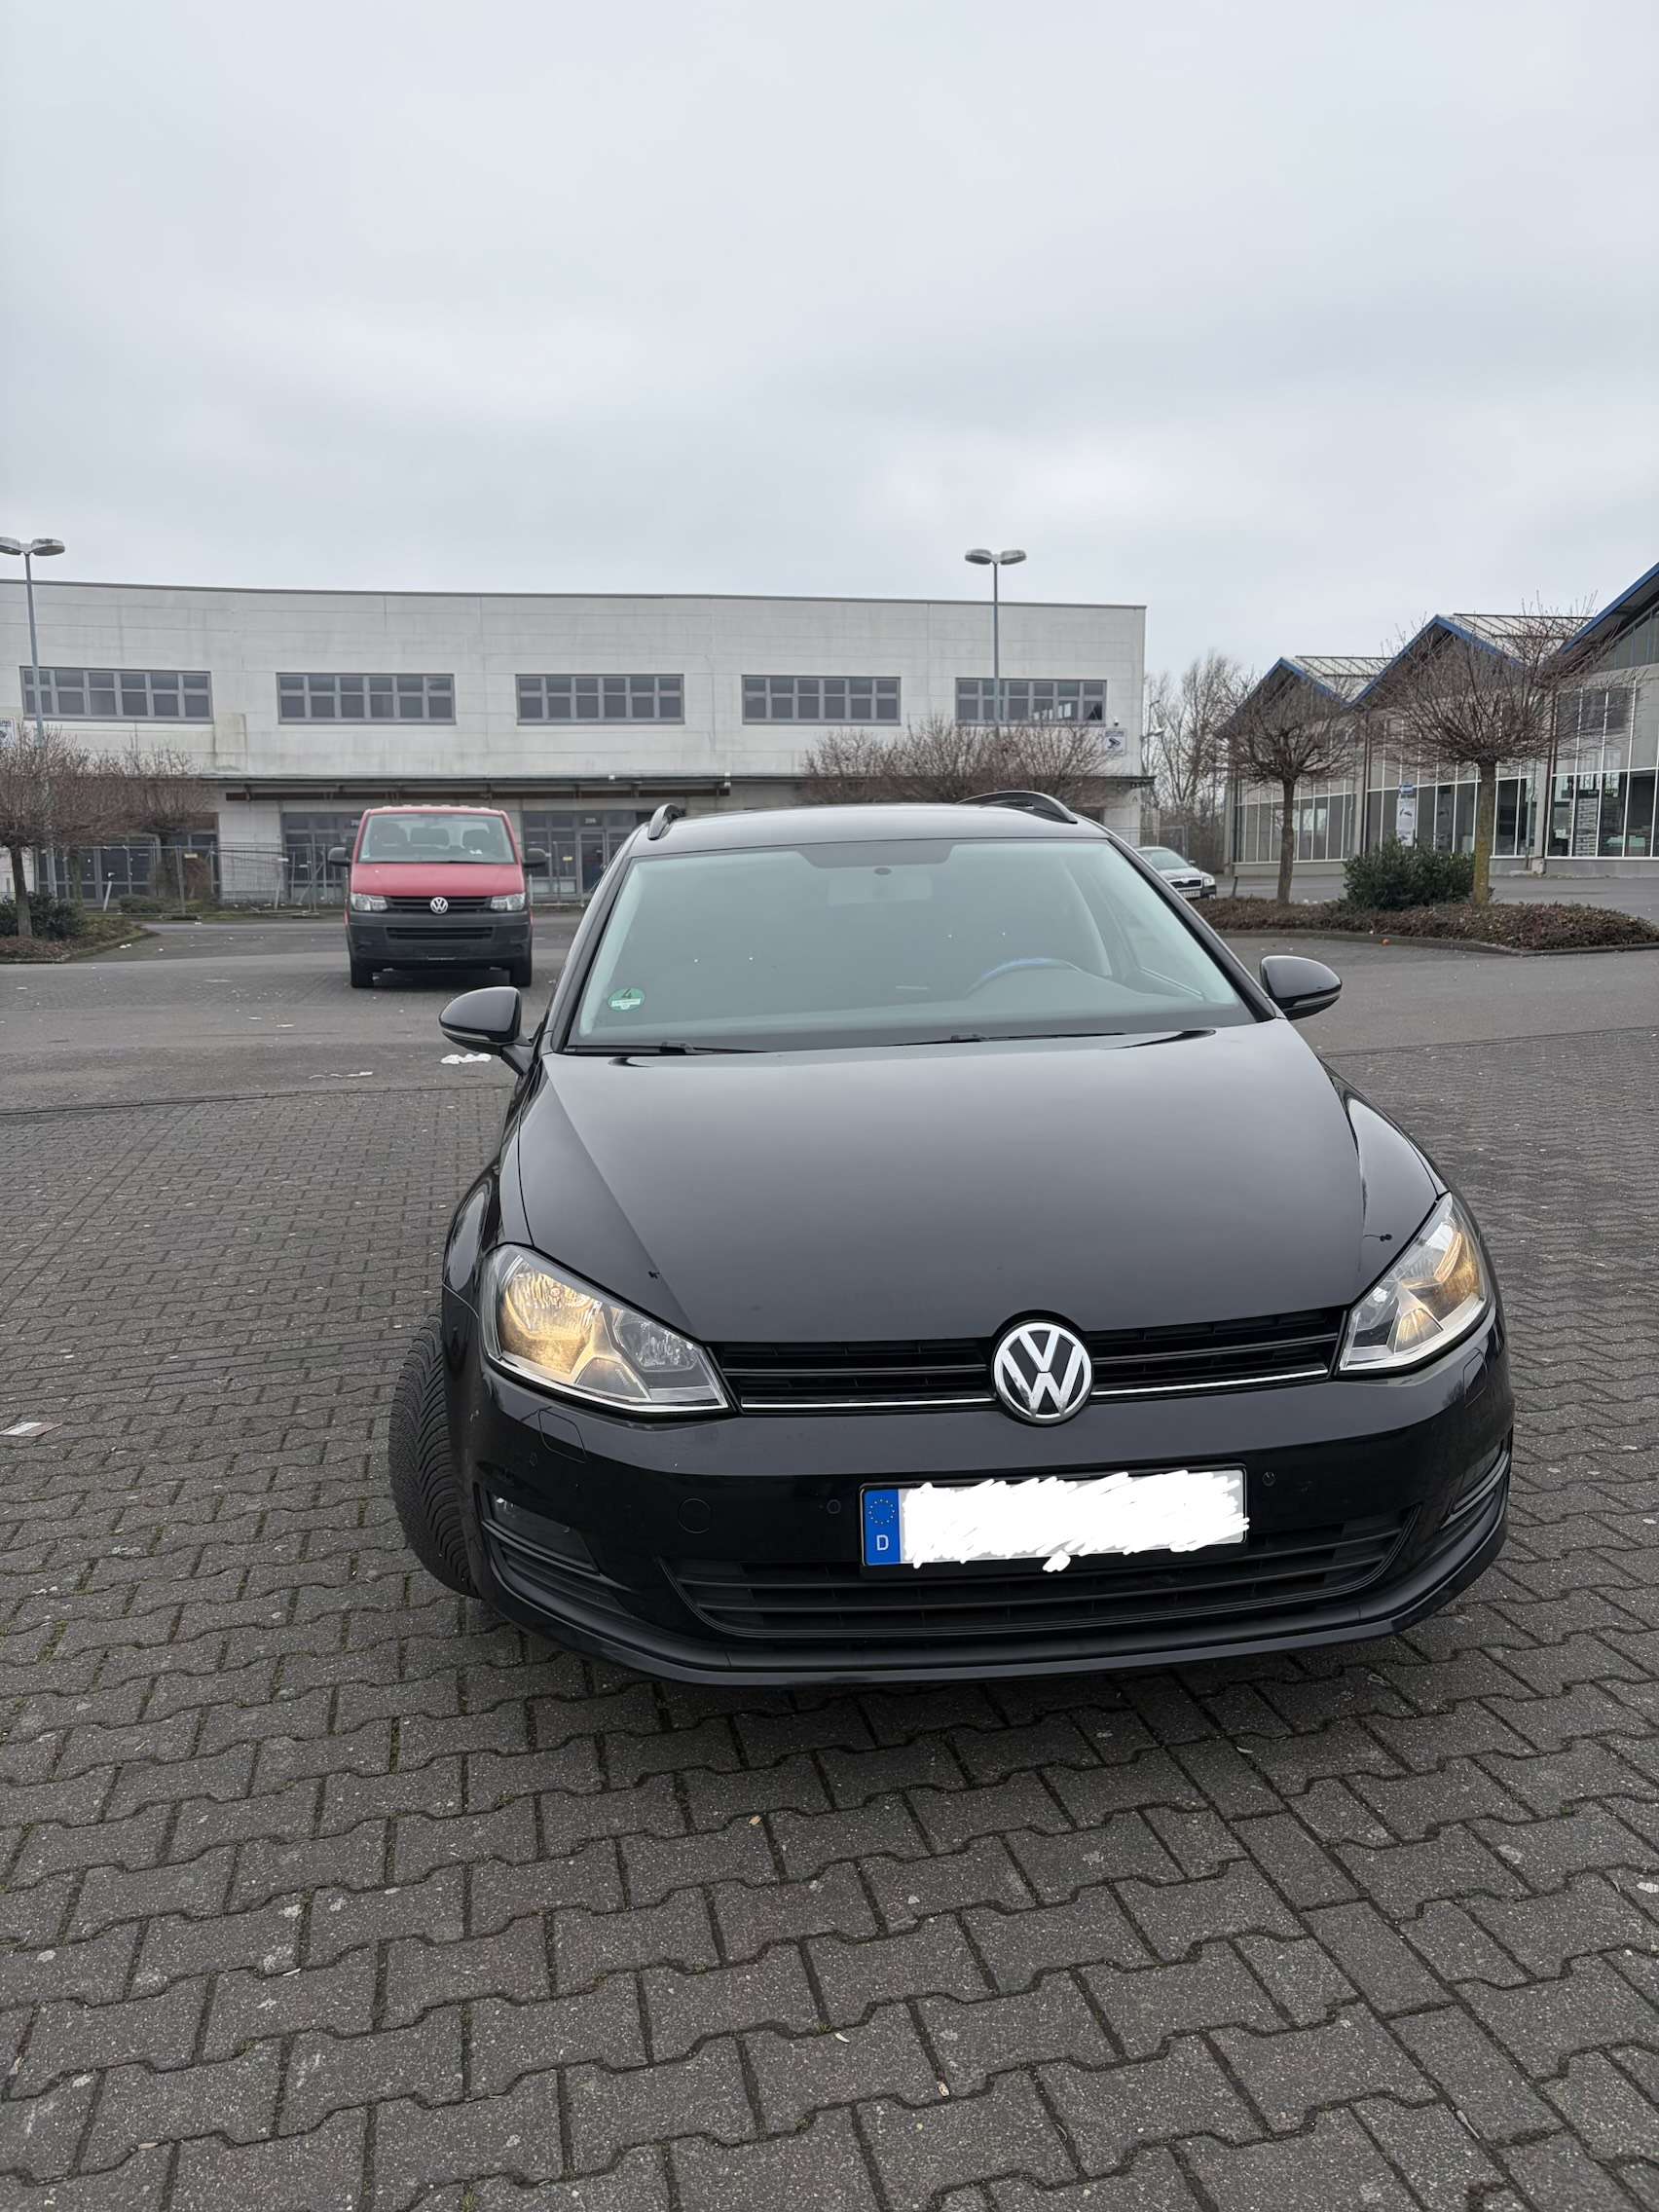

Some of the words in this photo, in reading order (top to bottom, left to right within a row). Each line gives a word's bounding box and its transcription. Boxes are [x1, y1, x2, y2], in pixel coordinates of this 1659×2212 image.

[430, 897, 448, 914] VW
[621, 988, 632, 999] 4
[996, 1325, 1089, 1418] VW
[876, 1534, 889, 1551] D
